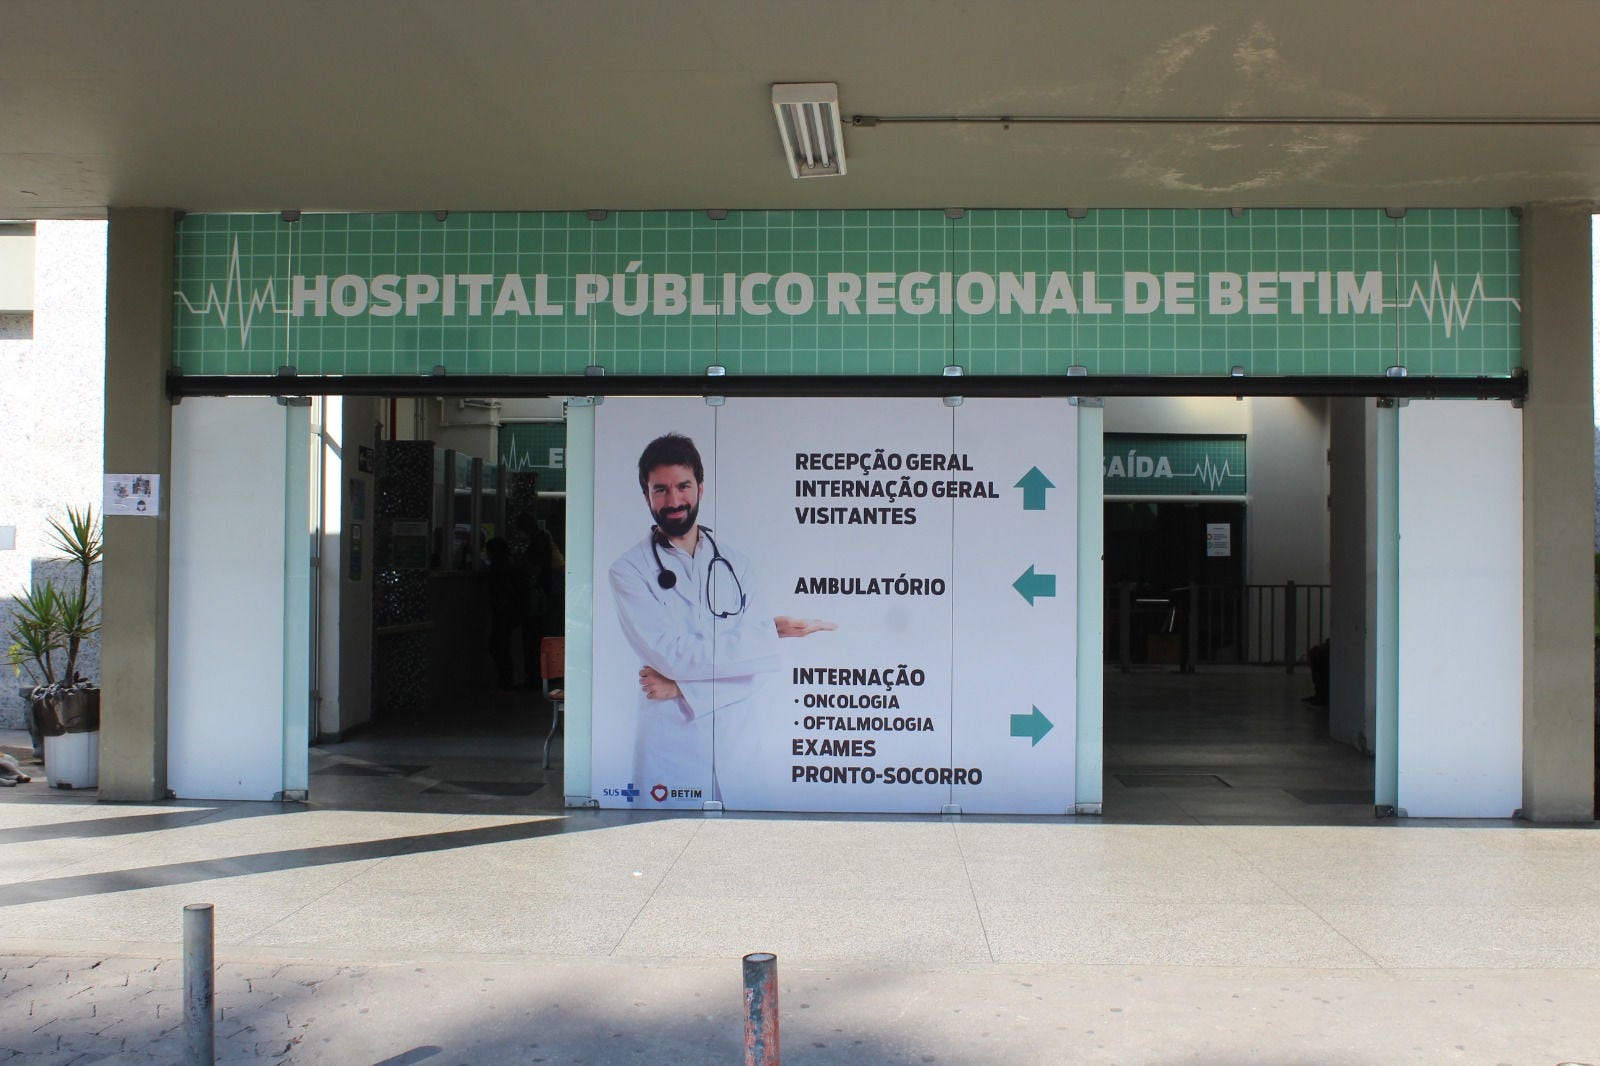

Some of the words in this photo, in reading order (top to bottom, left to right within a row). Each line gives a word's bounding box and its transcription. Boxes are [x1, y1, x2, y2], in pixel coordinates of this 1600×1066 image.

[291, 273, 563, 317] HOSPITAL
[575, 260, 814, 317] PÚBLICO
[827, 271, 1112, 315] REGIONAL
[1123, 271, 1195, 315] DE
[1208, 270, 1383, 315] BETIM
[795, 448, 902, 475] RECEPÇÃO
[905, 453, 974, 471] GERAL
[1103, 449, 1173, 478] AÍDA
[795, 476, 928, 502] INTERNAÇÃO
[931, 480, 1000, 499] GERAL
[795, 506, 917, 525] VISITANTES
[794, 572, 946, 596] AMBULATÓRIO
[792, 663, 925, 690] INTERNAÇÃO
[803, 693, 900, 710] ONCOLOGIA
[803, 715, 935, 732] OFTALMOLOGIA
[792, 738, 877, 757] EXAMES
[791, 765, 983, 786] PRONTO-SOCORRO
[603, 788, 620, 797] SUS
[671, 788, 702, 798] BETIM
